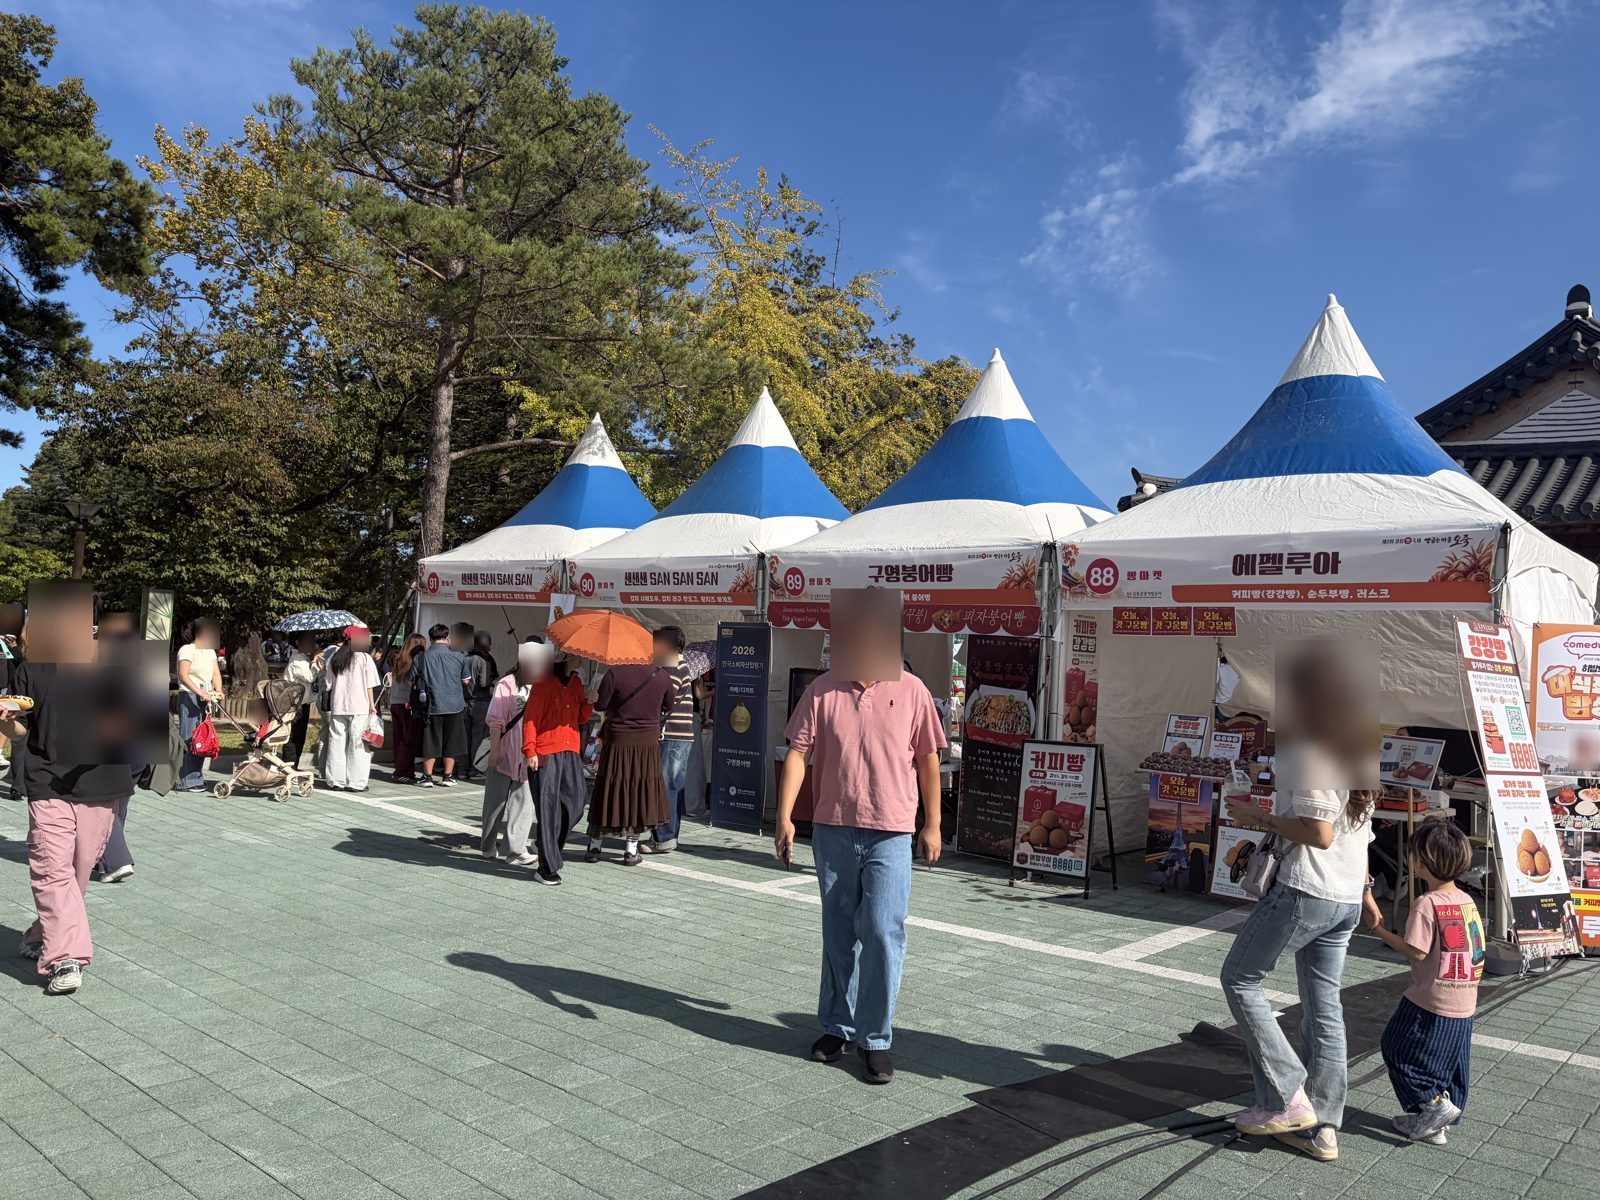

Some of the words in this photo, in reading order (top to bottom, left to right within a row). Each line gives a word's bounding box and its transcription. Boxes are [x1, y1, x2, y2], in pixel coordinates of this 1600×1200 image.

[1232, 550, 1342, 577] 에펠루아
[480, 573, 496, 586] SAN
[497, 573, 514, 586] SAN
[515, 573, 533, 586] SAN
[650, 571, 669, 586] SAN
[673, 571, 694, 586] SAN
[696, 571, 718, 586] SAN
[868, 563, 954, 583] 구영붕어빵
[1089, 567, 1115, 587] 88
[1126, 570, 1162, 581] 빵마켓
[429, 577, 438, 590] 91
[581, 579, 593, 592] 90
[786, 574, 801, 590] 89
[1307, 588, 1353, 600] 순두부빵,
[1356, 588, 1390, 599] 러스크
[963, 608, 1027, 628] 피자붕어빵
[732, 645, 755, 655] 2026
[1030, 750, 1086, 773] 커피빵
[1438, 907, 1452, 917] red
